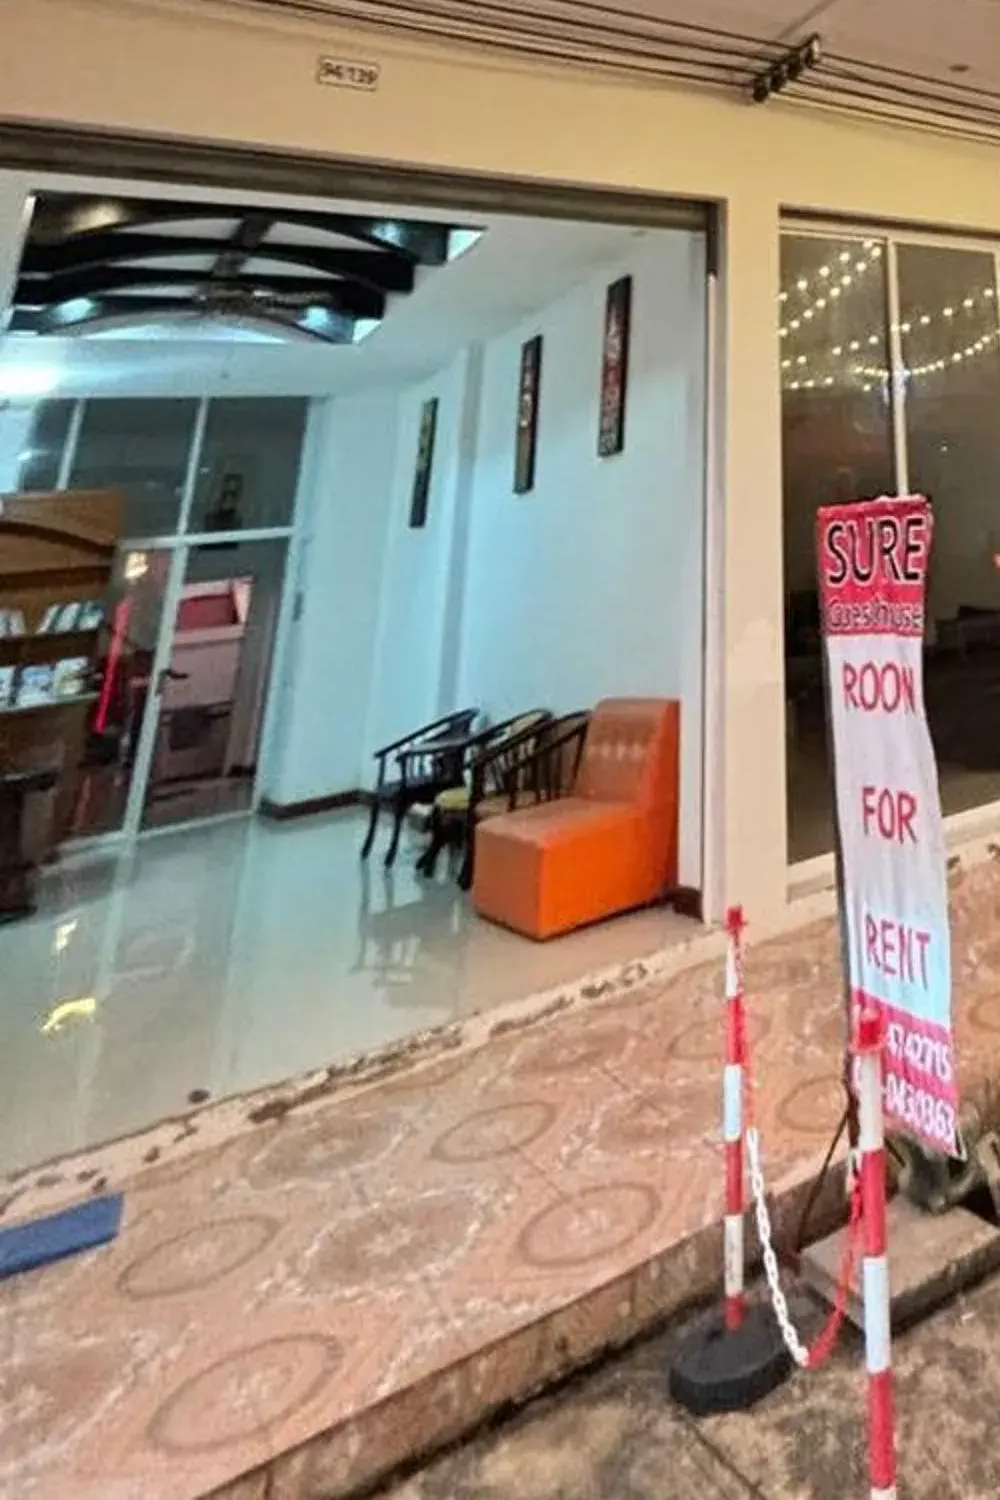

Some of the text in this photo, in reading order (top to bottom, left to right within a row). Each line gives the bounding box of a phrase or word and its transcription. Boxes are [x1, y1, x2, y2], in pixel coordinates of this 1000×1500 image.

[825, 515, 926, 587] SURE
[862, 787, 918, 844] FOR
[865, 913, 931, 991] RENT
